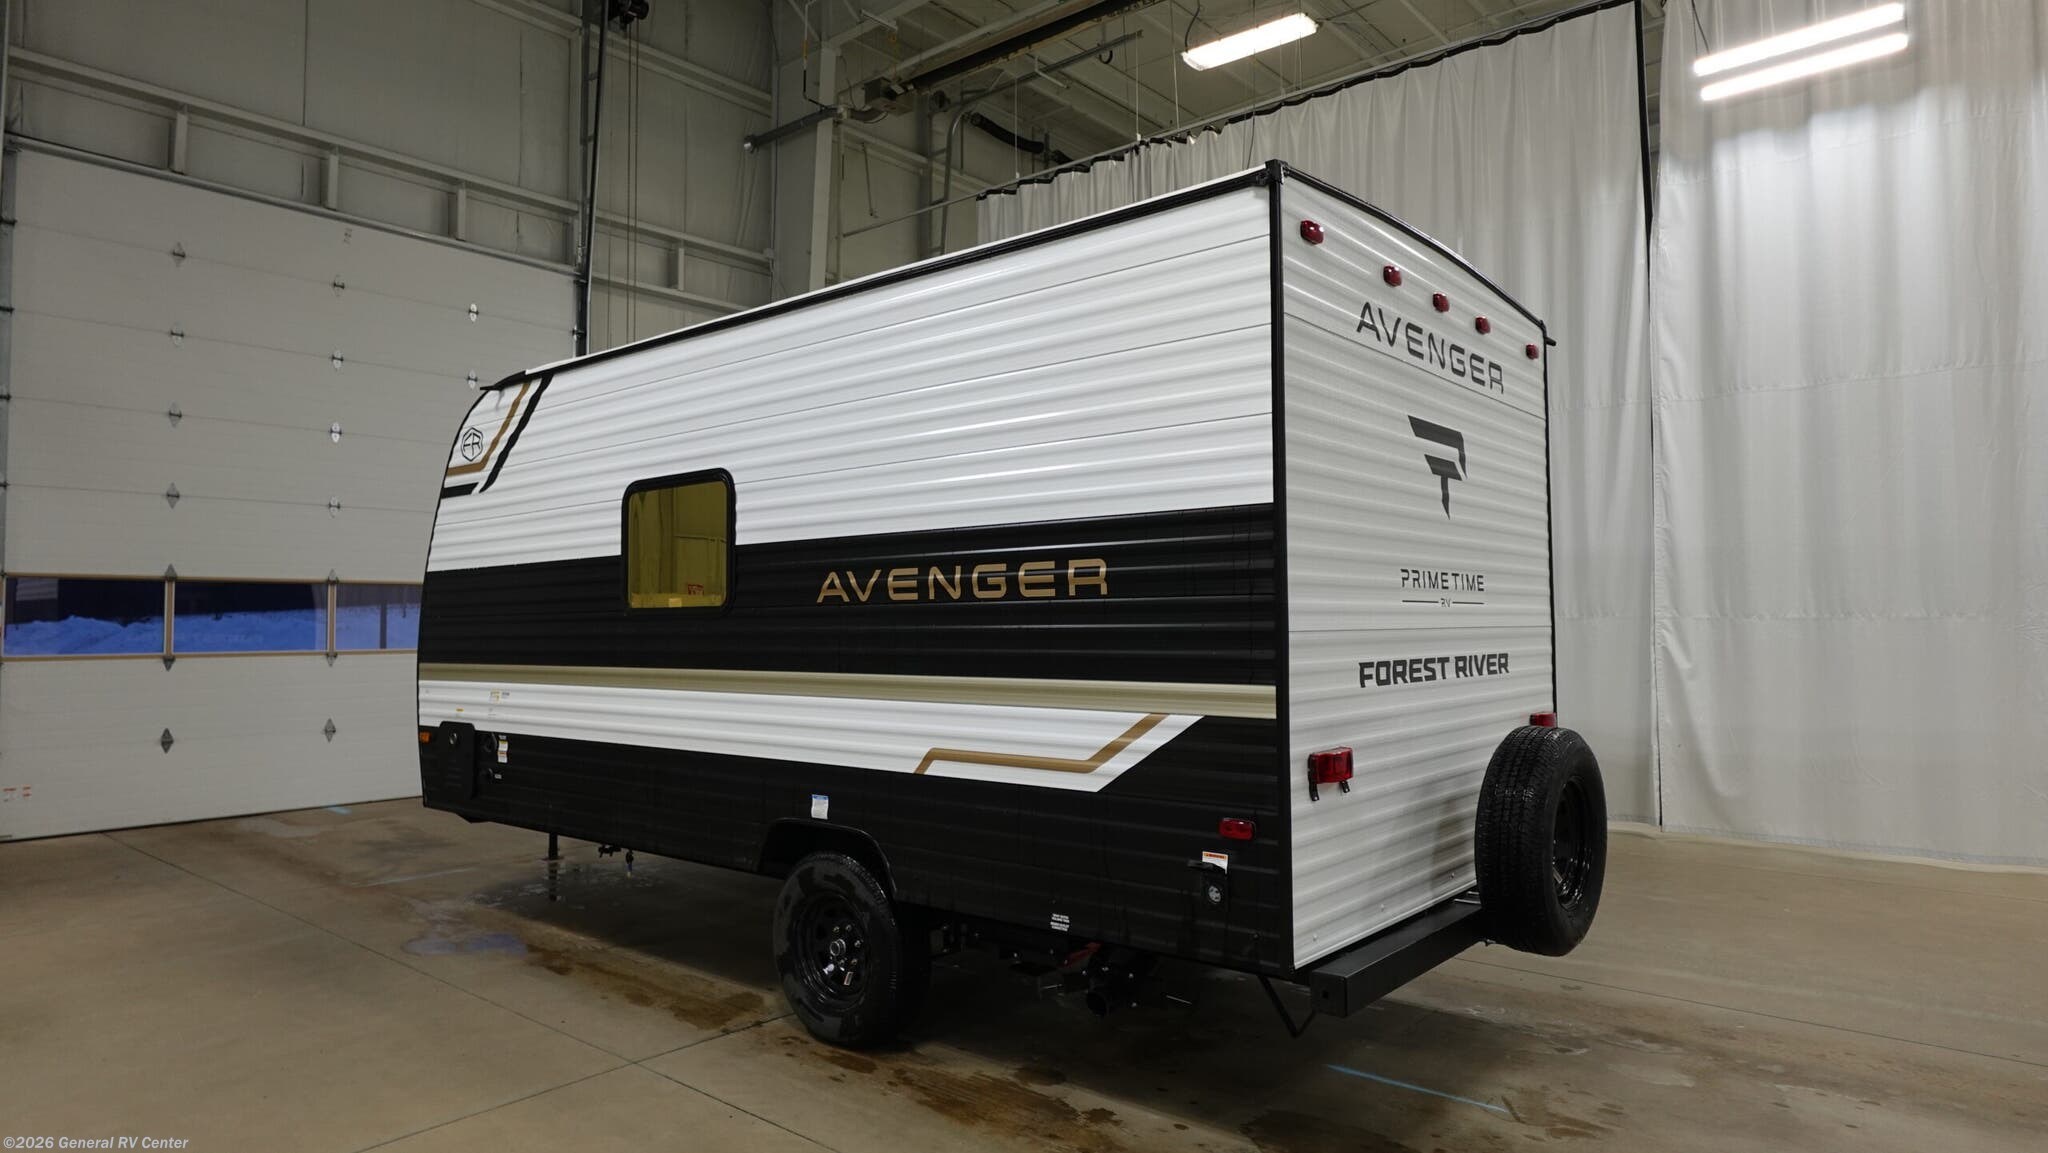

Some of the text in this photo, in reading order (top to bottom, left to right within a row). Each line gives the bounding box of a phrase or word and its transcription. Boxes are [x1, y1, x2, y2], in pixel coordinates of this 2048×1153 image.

[1356, 302, 1505, 394] AVENGER
[816, 558, 1109, 603] AVENGER
[1358, 652, 1510, 688] FOREST RIVER
